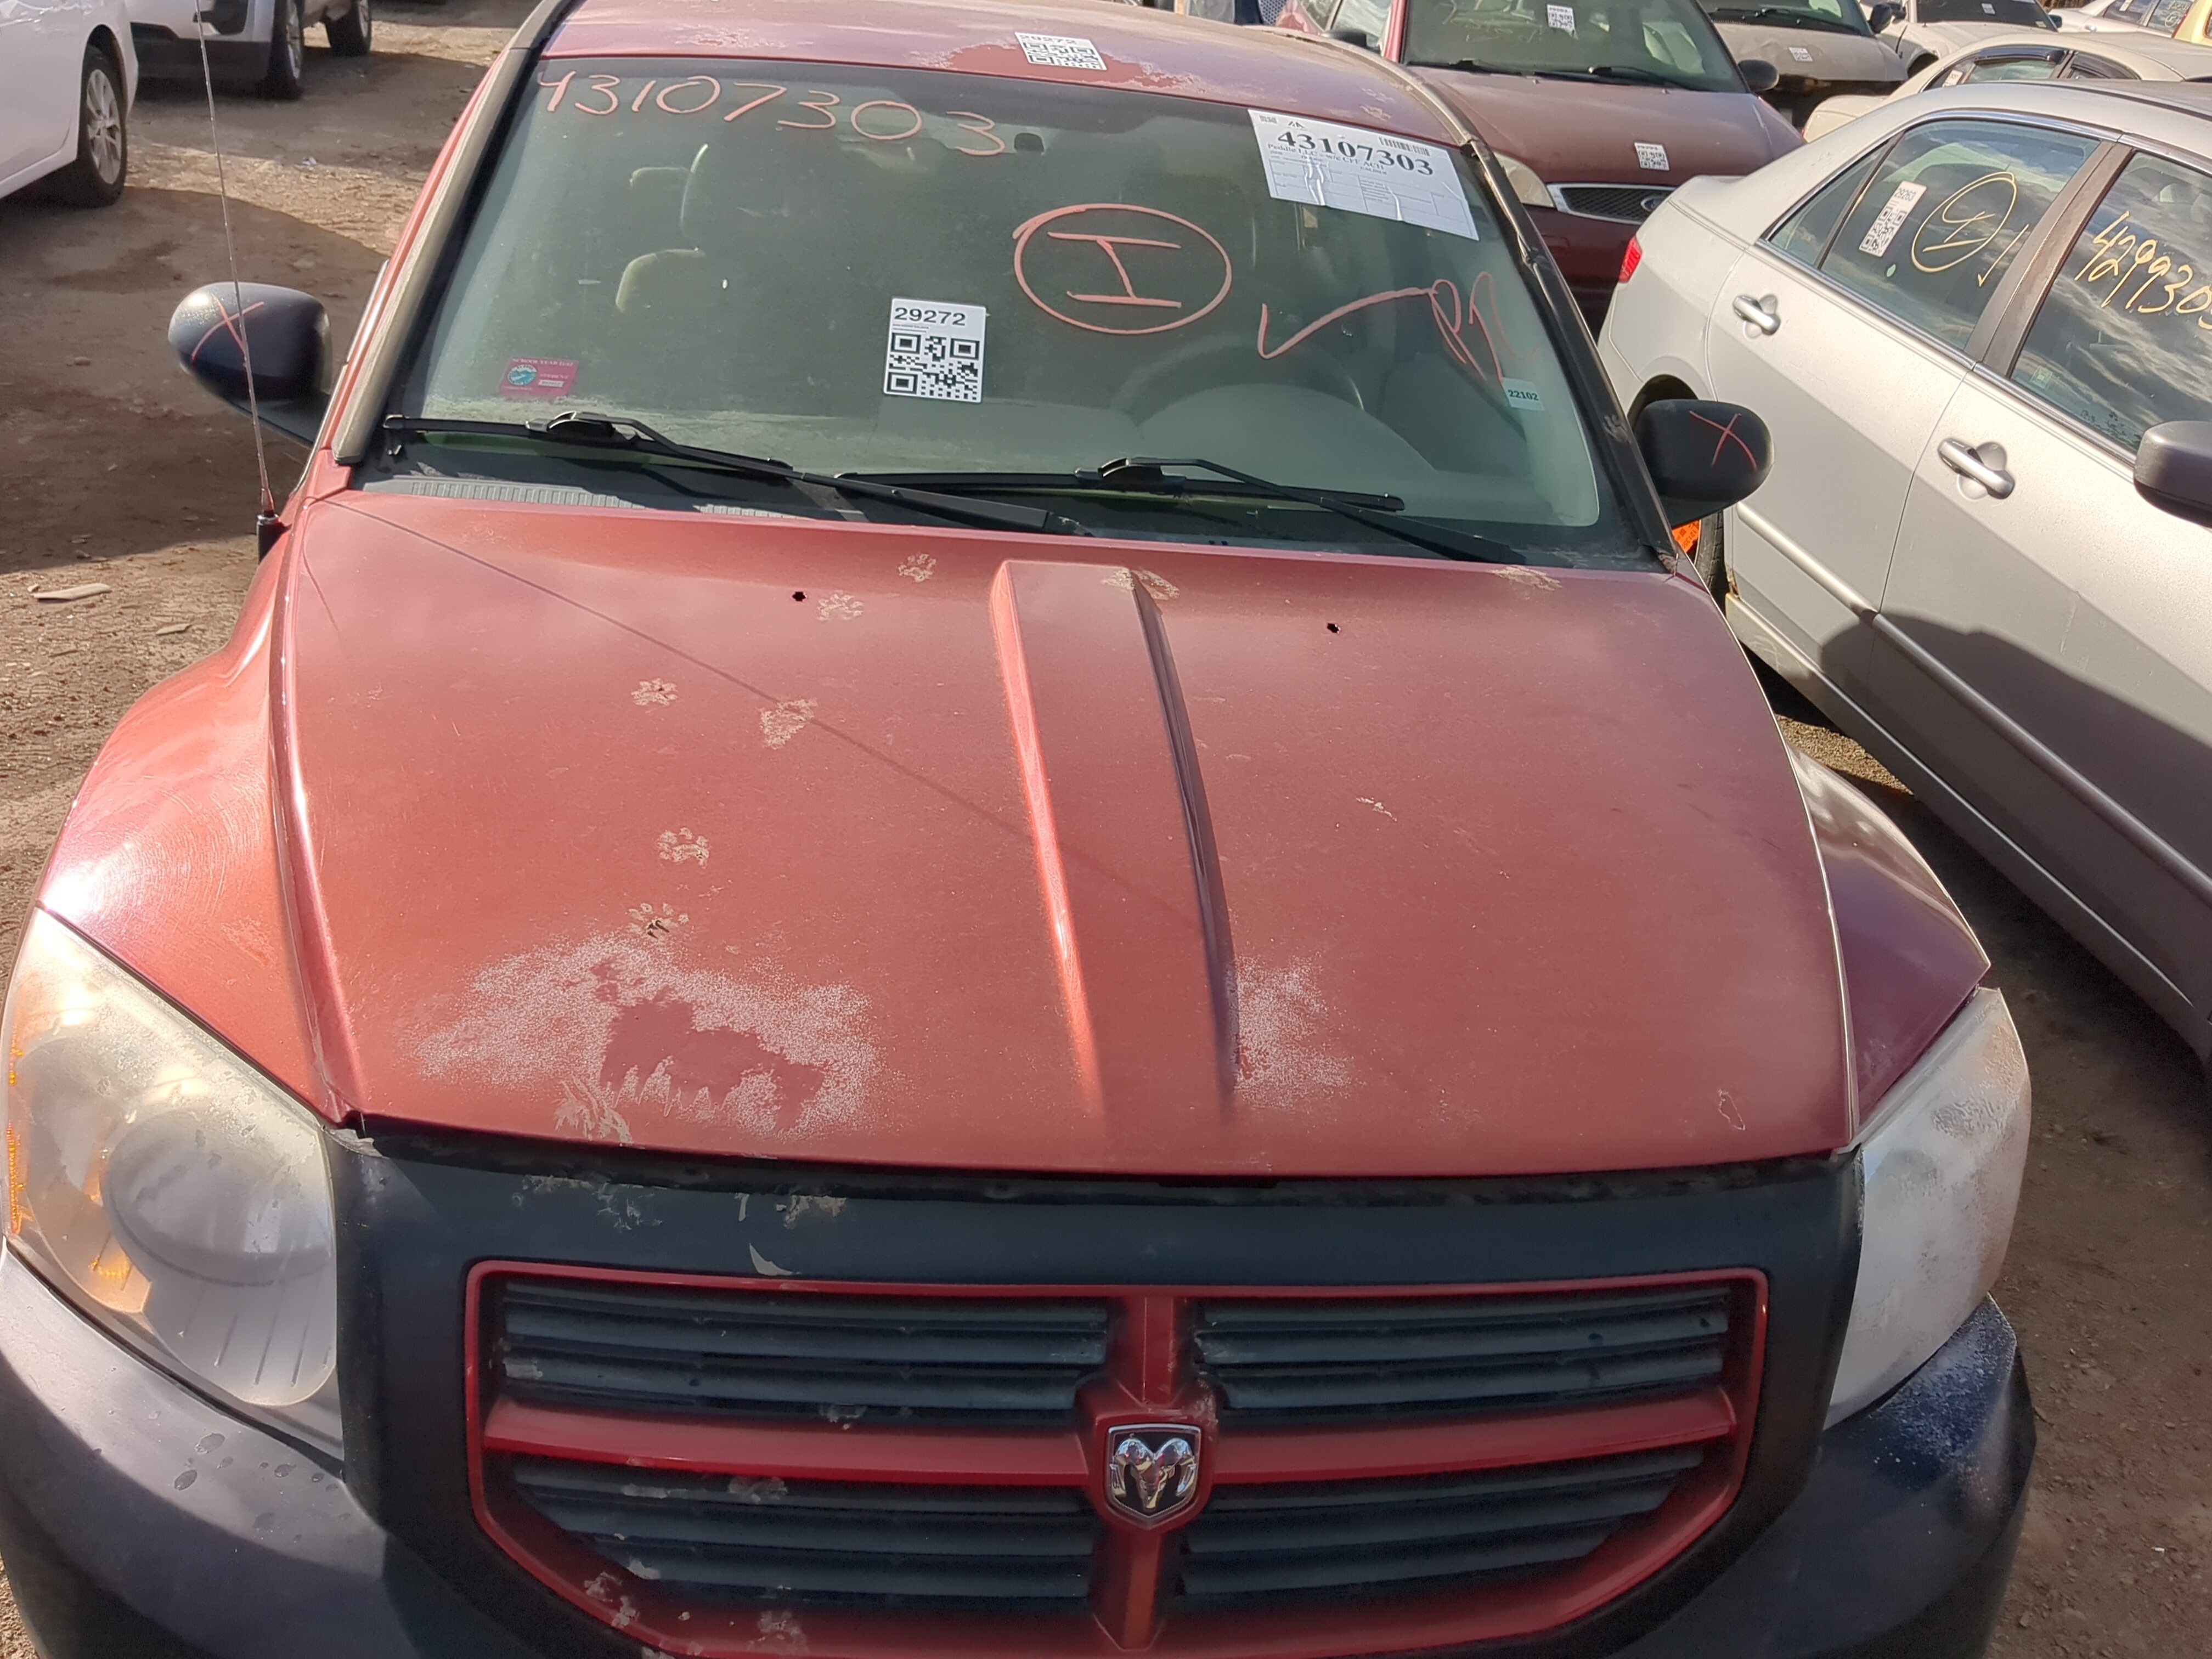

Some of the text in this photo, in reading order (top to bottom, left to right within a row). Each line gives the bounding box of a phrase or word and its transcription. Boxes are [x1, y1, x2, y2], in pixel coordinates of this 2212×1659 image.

[536, 71, 1007, 156] 43107303
[1268, 144, 1296, 153] Peddle
[1277, 131, 1434, 176] 43107303
[1894, 188, 1917, 201] 29263
[894, 307, 966, 326] 29272
[1508, 389, 1539, 401] 22102
